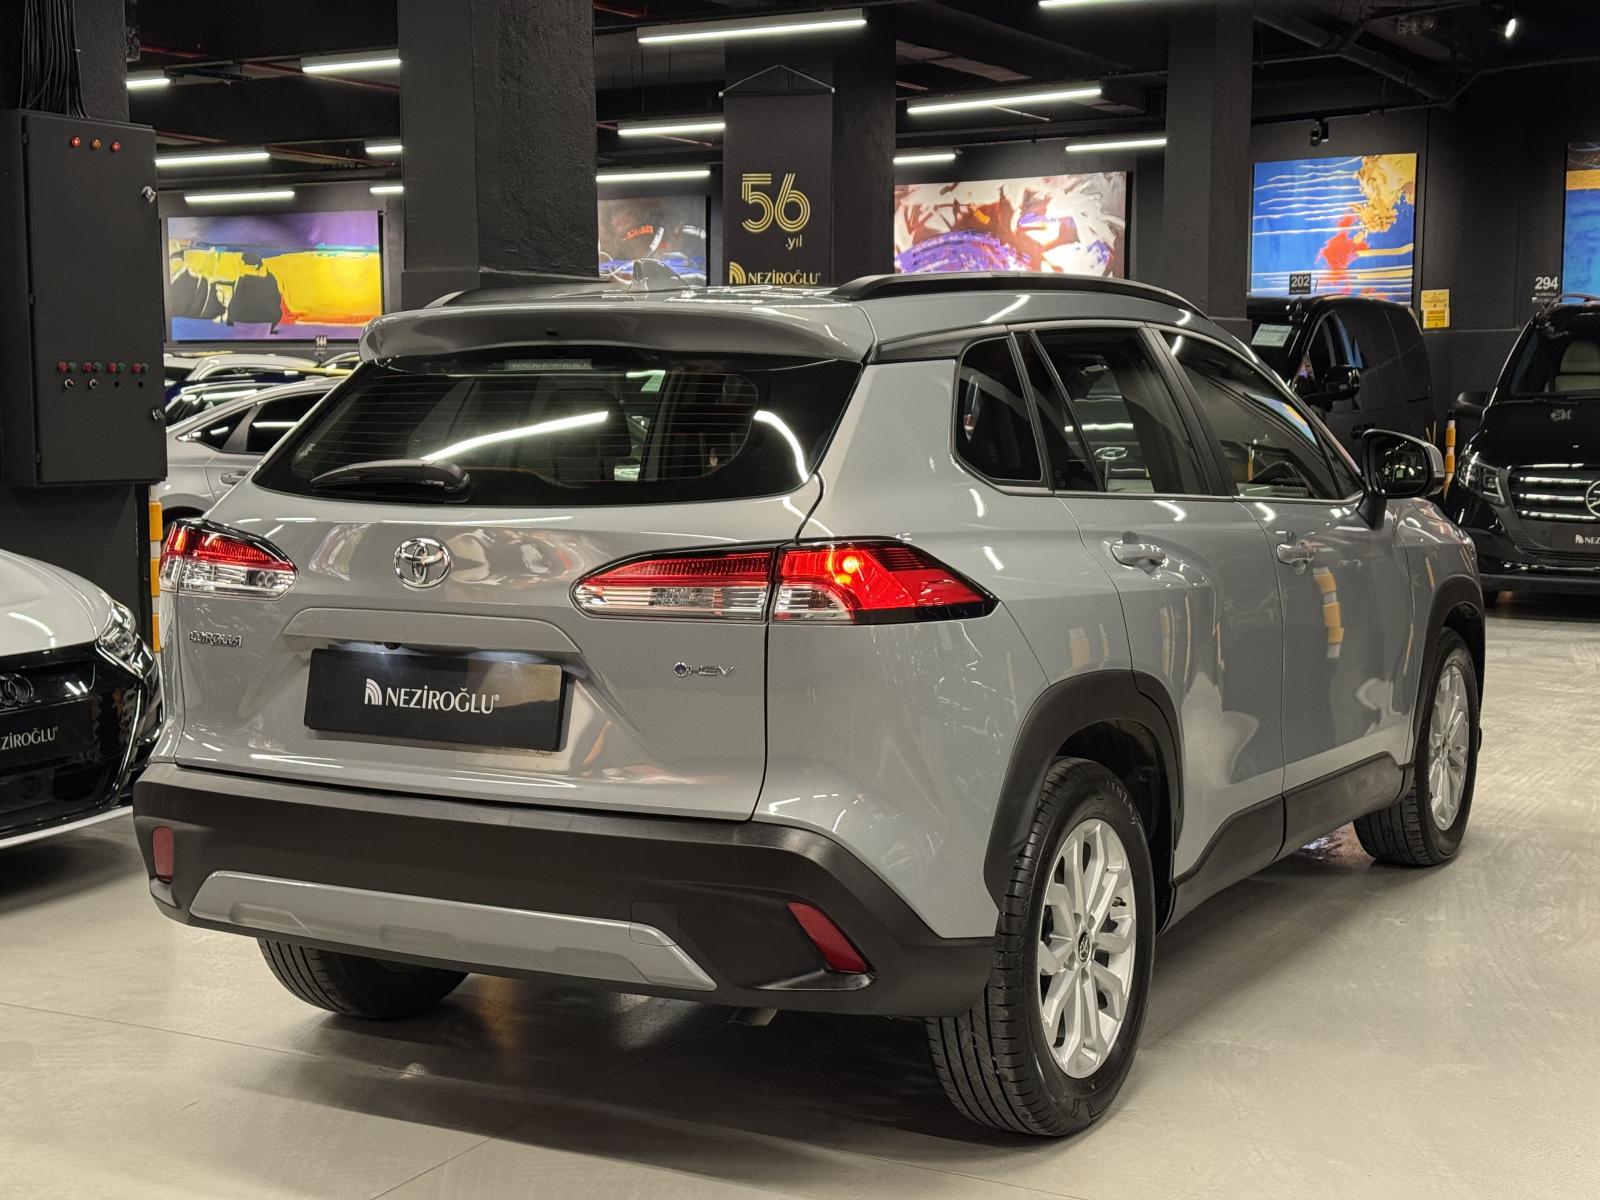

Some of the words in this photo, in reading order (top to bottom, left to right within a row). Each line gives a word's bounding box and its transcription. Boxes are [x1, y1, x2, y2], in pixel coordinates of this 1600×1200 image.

[742, 173, 811, 232] 56
[1291, 275, 1310, 287] 202
[1535, 276, 1558, 290] 294
[0, 727, 56, 750] ZİROĞLU
